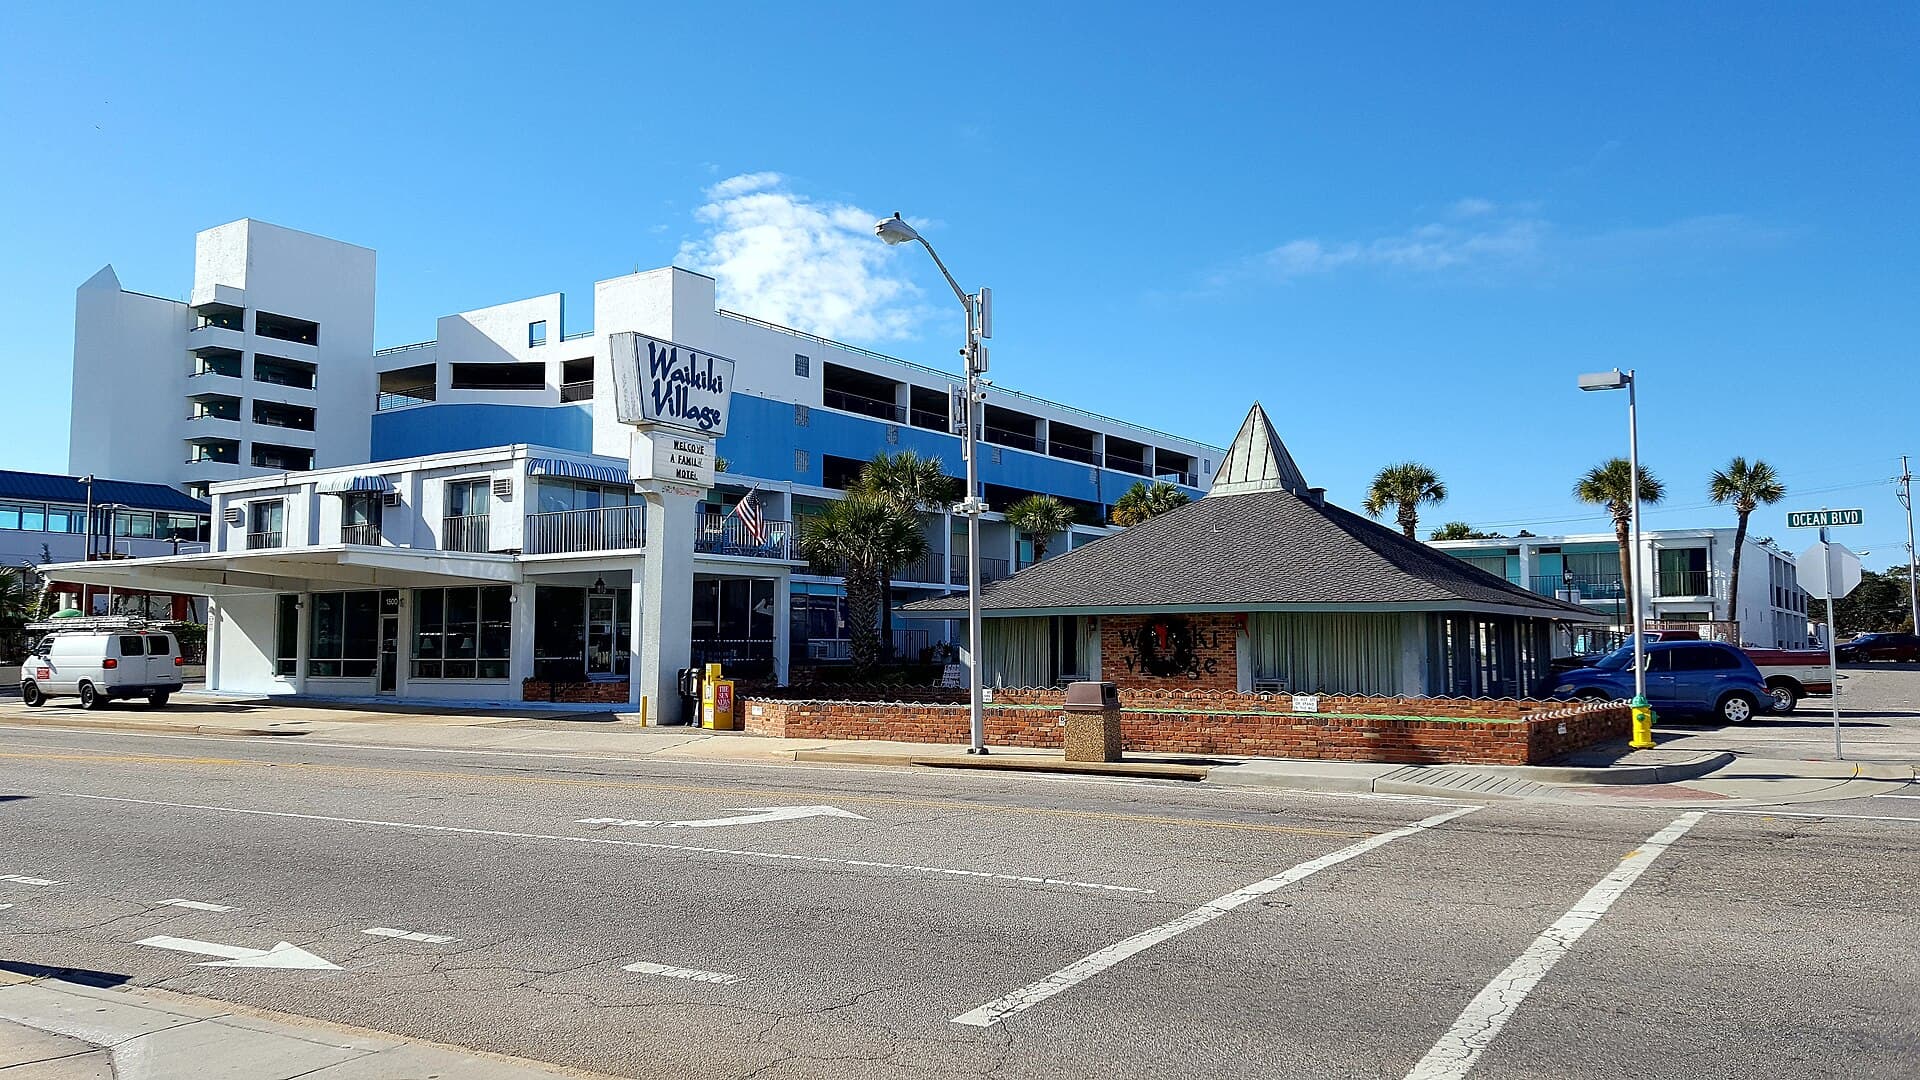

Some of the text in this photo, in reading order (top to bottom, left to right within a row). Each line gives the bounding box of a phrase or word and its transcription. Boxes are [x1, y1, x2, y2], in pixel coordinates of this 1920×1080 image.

[648, 341, 723, 394] Waikiki
[651, 378, 721, 430] Village
[670, 453, 676, 463] A
[676, 469, 699, 480] MOTEL
[1792, 511, 1858, 526] OCEAN BLVD
